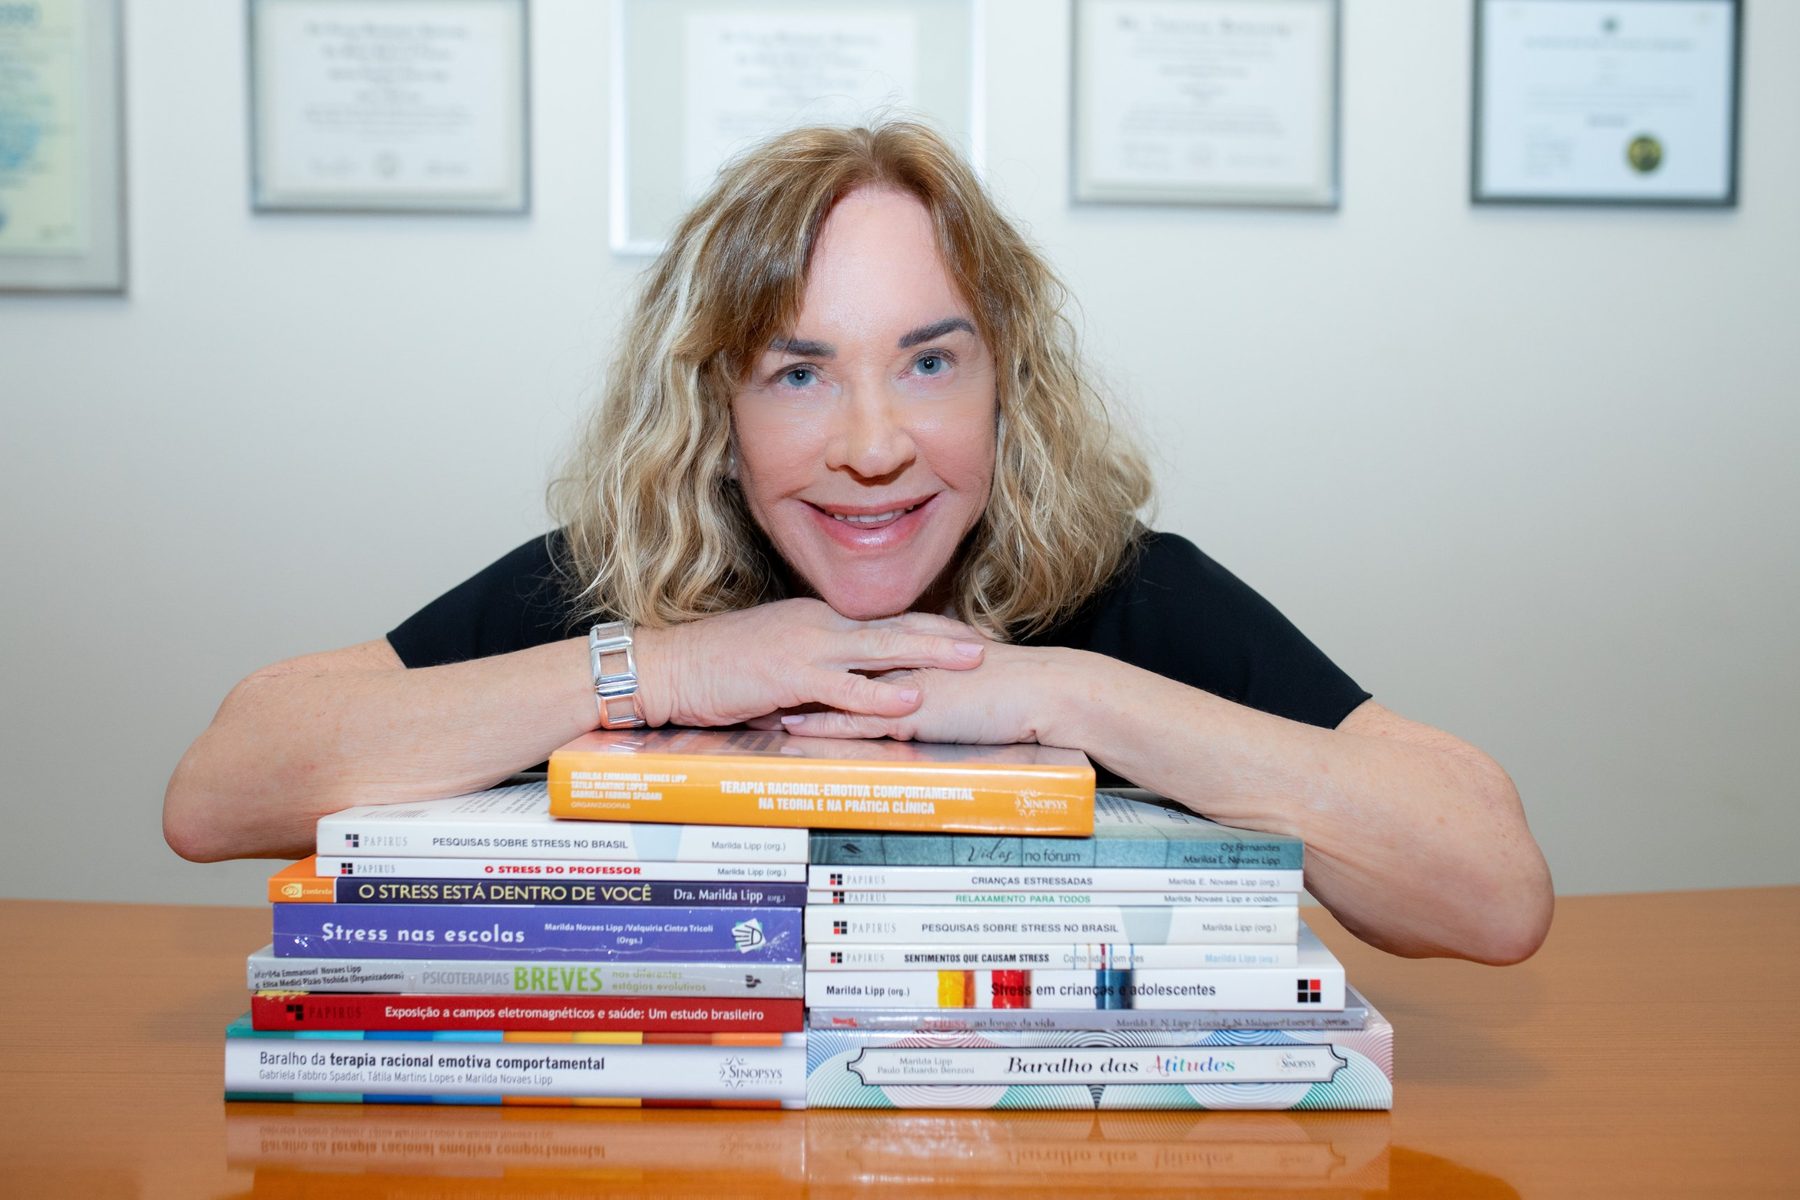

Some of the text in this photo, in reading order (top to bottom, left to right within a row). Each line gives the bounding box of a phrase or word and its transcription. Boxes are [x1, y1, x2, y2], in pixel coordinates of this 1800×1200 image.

[671, 774, 687, 783] LIPP
[720, 781, 975, 801] TERAPIA RACIONAL-EMOTIVA COMPORTAMENTAL
[758, 797, 935, 814] NA TEORIA E NA PRÁTICA CLÍNICA
[363, 836, 408, 847] PAPIRUS
[433, 837, 629, 850] PESQUISAS SOBRE STRESS NO BRASIL
[711, 841, 786, 852] Marilda Lipp (org.)
[1024, 853, 1041, 862] no
[1043, 848, 1081, 863] fórum
[1183, 855, 1217, 864] Marilda
[1261, 856, 1280, 866] Lipp
[356, 864, 396, 874] PAPIRUS
[484, 865, 641, 875] O STRESS DO PROFESSOR
[717, 867, 786, 878] Marilda Lipp (org.)
[846, 875, 886, 885] PAPIRUS
[971, 876, 1093, 887] CRIANÇAS ESTRESSADAS
[1168, 877, 1196, 886] Marilda
[1209, 878, 1238, 886] Novaes
[1240, 878, 1257, 888] Lipp
[358, 882, 652, 901] O STRESS ESTÁ DENTRO DE VOCÊ
[674, 888, 786, 904] Dra. Marilda Lipp (org.)
[848, 893, 887, 902] PAPIRUS
[955, 894, 1091, 903] RELAXAMENTO PARA TODOS
[1164, 895, 1192, 903] Marilda
[1194, 895, 1223, 903] Novaes
[1226, 895, 1243, 904] Lipp
[320, 922, 525, 943] Stress nas escolas
[544, 922, 575, 931] Marilda
[576, 923, 604, 932] Novaes
[605, 923, 623, 933] Lipp
[664, 923, 687, 932] Cintra
[689, 923, 713, 933] Tricoli
[852, 923, 896, 934] PAPIRUS
[921, 923, 1119, 933] PESQUISAS SOBRE STRESS NO BRASIL
[1202, 923, 1277, 934] Marilda Lipp (org.)
[616, 935, 643, 945] (Orgs.)
[846, 953, 885, 963] PAPIRUS
[904, 953, 1050, 964] SENTIMENTOS QUE CAUSAM STRESS
[1204, 954, 1236, 963] Marilda
[1238, 954, 1256, 965] Lipp
[282, 965, 362, 978] Emmanuel Novaes Lipp
[612, 971, 629, 979] nos
[322, 975, 348, 985] Yoshida
[422, 967, 603, 992] PSICOTERAPIAS BREVES
[612, 981, 706, 993] estágios evolutivos
[826, 985, 910, 997] Marilda Lipp (org.)
[991, 984, 1216, 998] Stress em crianças adolescentes
[308, 1006, 362, 1019] PAPIRUS
[385, 1006, 764, 1021] Exposição a campos eletromagnéticos e saúde: Um estudo brasileiro
[1018, 1019, 1032, 1028] da
[1034, 1019, 1055, 1028] vida
[259, 1051, 605, 1072] Baralho da terapia racional emotiva comportamental
[899, 1057, 953, 1068] Marilda Lipp
[1006, 1055, 1236, 1076] Baralho das Atitudes
[729, 1065, 782, 1078] SINOPSYS
[877, 1066, 900, 1075] Paulo
[903, 1066, 938, 1075] Eduardo
[259, 1070, 296, 1081] Gabriela
[297, 1070, 327, 1081] Fabbro
[368, 1070, 393, 1082] Tátila
[395, 1071, 427, 1083] Martins
[429, 1072, 455, 1085] Lopes
[457, 1075, 463, 1083] e
[465, 1072, 498, 1084] Marilda
[500, 1073, 532, 1085] Novaes
[534, 1073, 553, 1086] Lipp
